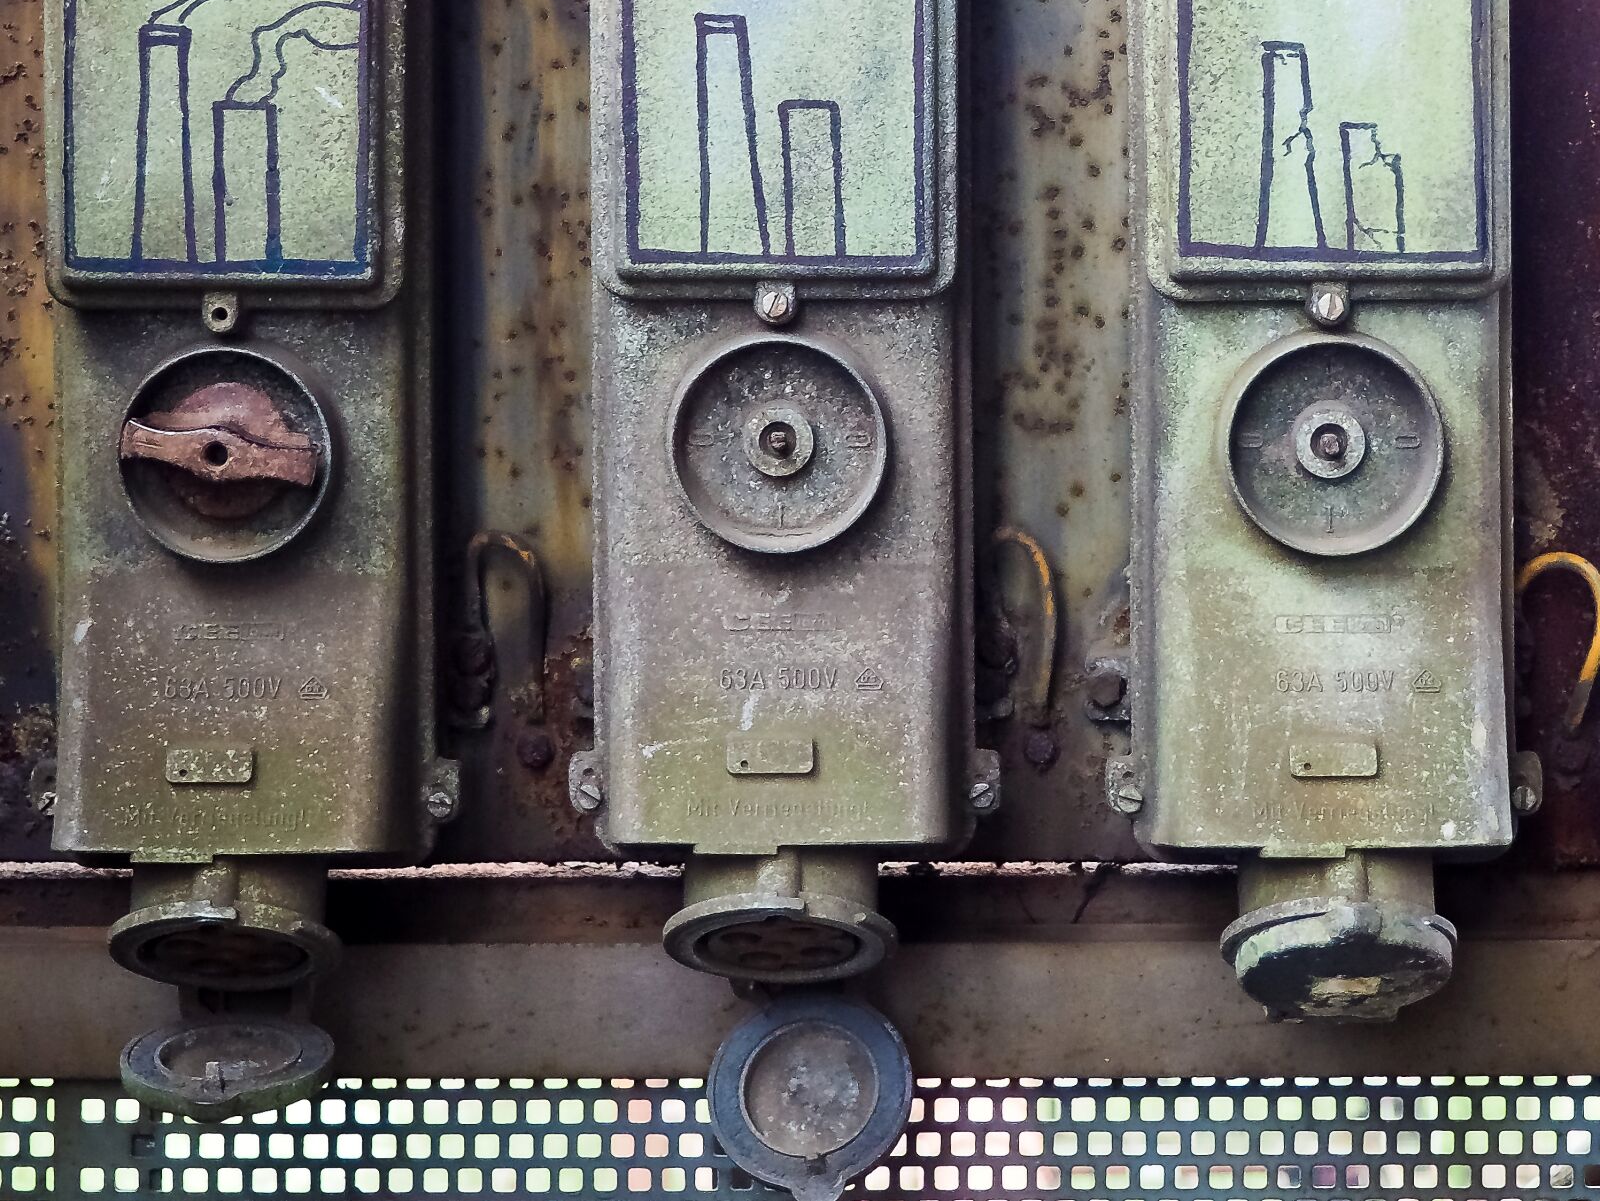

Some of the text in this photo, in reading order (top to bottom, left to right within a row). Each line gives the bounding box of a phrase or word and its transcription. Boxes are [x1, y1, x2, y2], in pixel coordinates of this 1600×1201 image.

[163, 676, 209, 699] 63A
[223, 675, 283, 699] 500V
[719, 667, 766, 691] 63A
[777, 666, 838, 690] 500V
[1275, 669, 1324, 693] 63A
[1335, 669, 1396, 693] 500V
